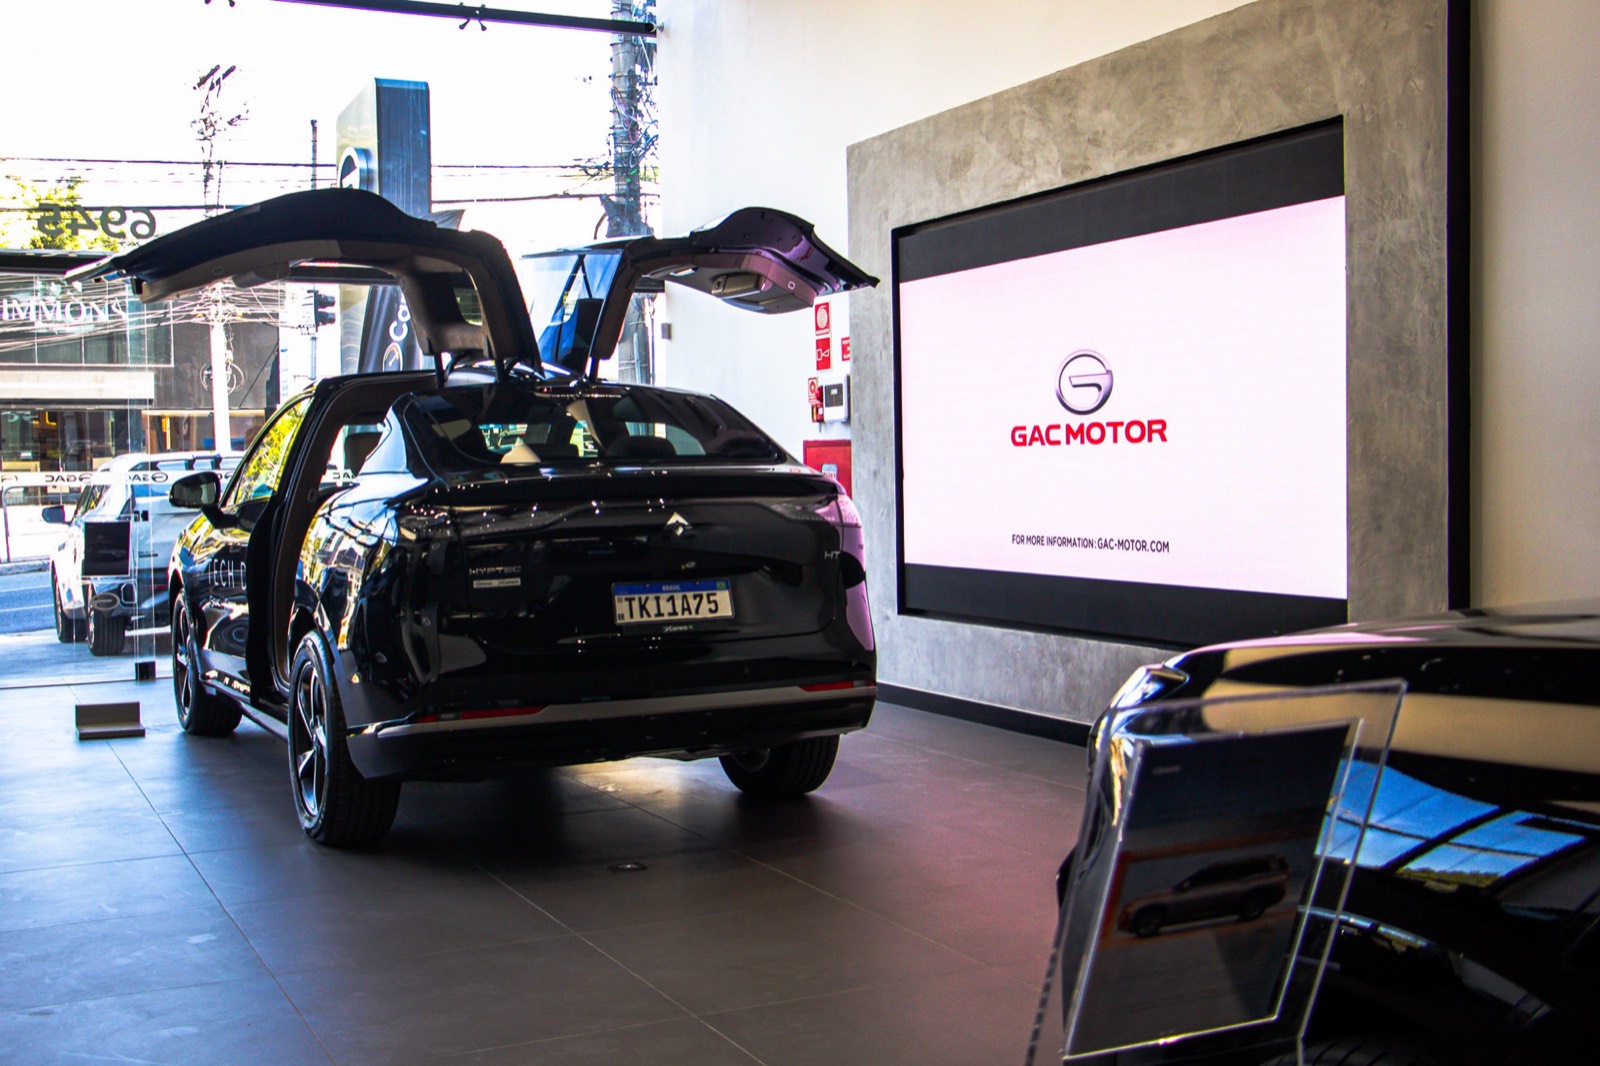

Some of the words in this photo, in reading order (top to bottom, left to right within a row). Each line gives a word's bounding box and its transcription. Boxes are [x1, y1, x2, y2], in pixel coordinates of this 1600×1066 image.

[1011, 533, 1025, 545] FOR
[1026, 535, 1045, 546] MORE
[1046, 535, 1097, 549] INFORMATION:
[1097, 537, 1170, 553] GAC-MOTOR.COM
[624, 592, 719, 619] TKI1A75
